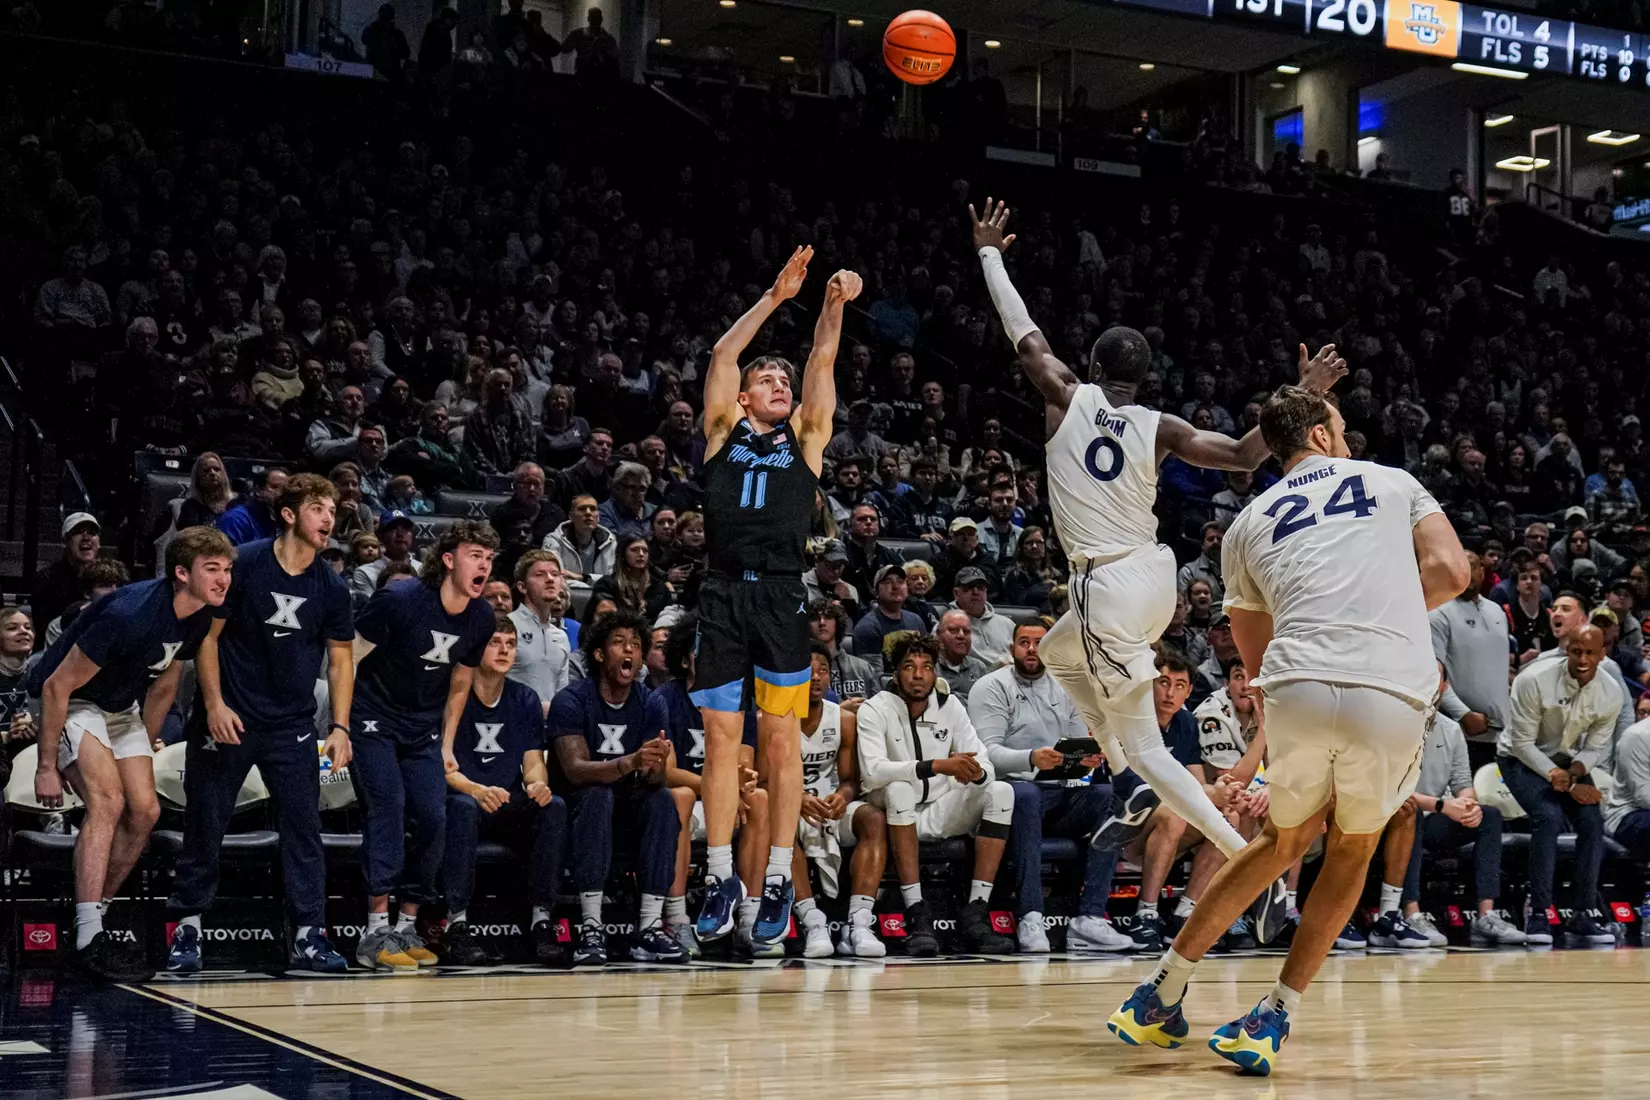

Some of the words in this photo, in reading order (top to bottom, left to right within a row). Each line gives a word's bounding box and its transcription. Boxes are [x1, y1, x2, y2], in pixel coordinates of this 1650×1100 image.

[1317, 0, 1376, 35] 20
[1482, 10, 1524, 38] TOL
[1533, 20, 1550, 43] 4
[1481, 37, 1522, 64] FLS
[1533, 46, 1550, 69] 5
[1580, 43, 1608, 61] PTS
[1618, 50, 1634, 66] 10
[316, 60, 342, 72] 107
[1580, 61, 1607, 78] FLS
[1619, 65, 1631, 82] 0
[1078, 159, 1098, 170] 109
[1084, 436, 1124, 482] 0
[1287, 464, 1338, 489] NUNGE
[740, 470, 768, 509] 11
[1262, 473, 1378, 545] 24
[801, 750, 837, 762] VIER
[204, 928, 275, 941] TOYOTA
[333, 925, 367, 938] TOY
[469, 924, 523, 937] OYOTA
